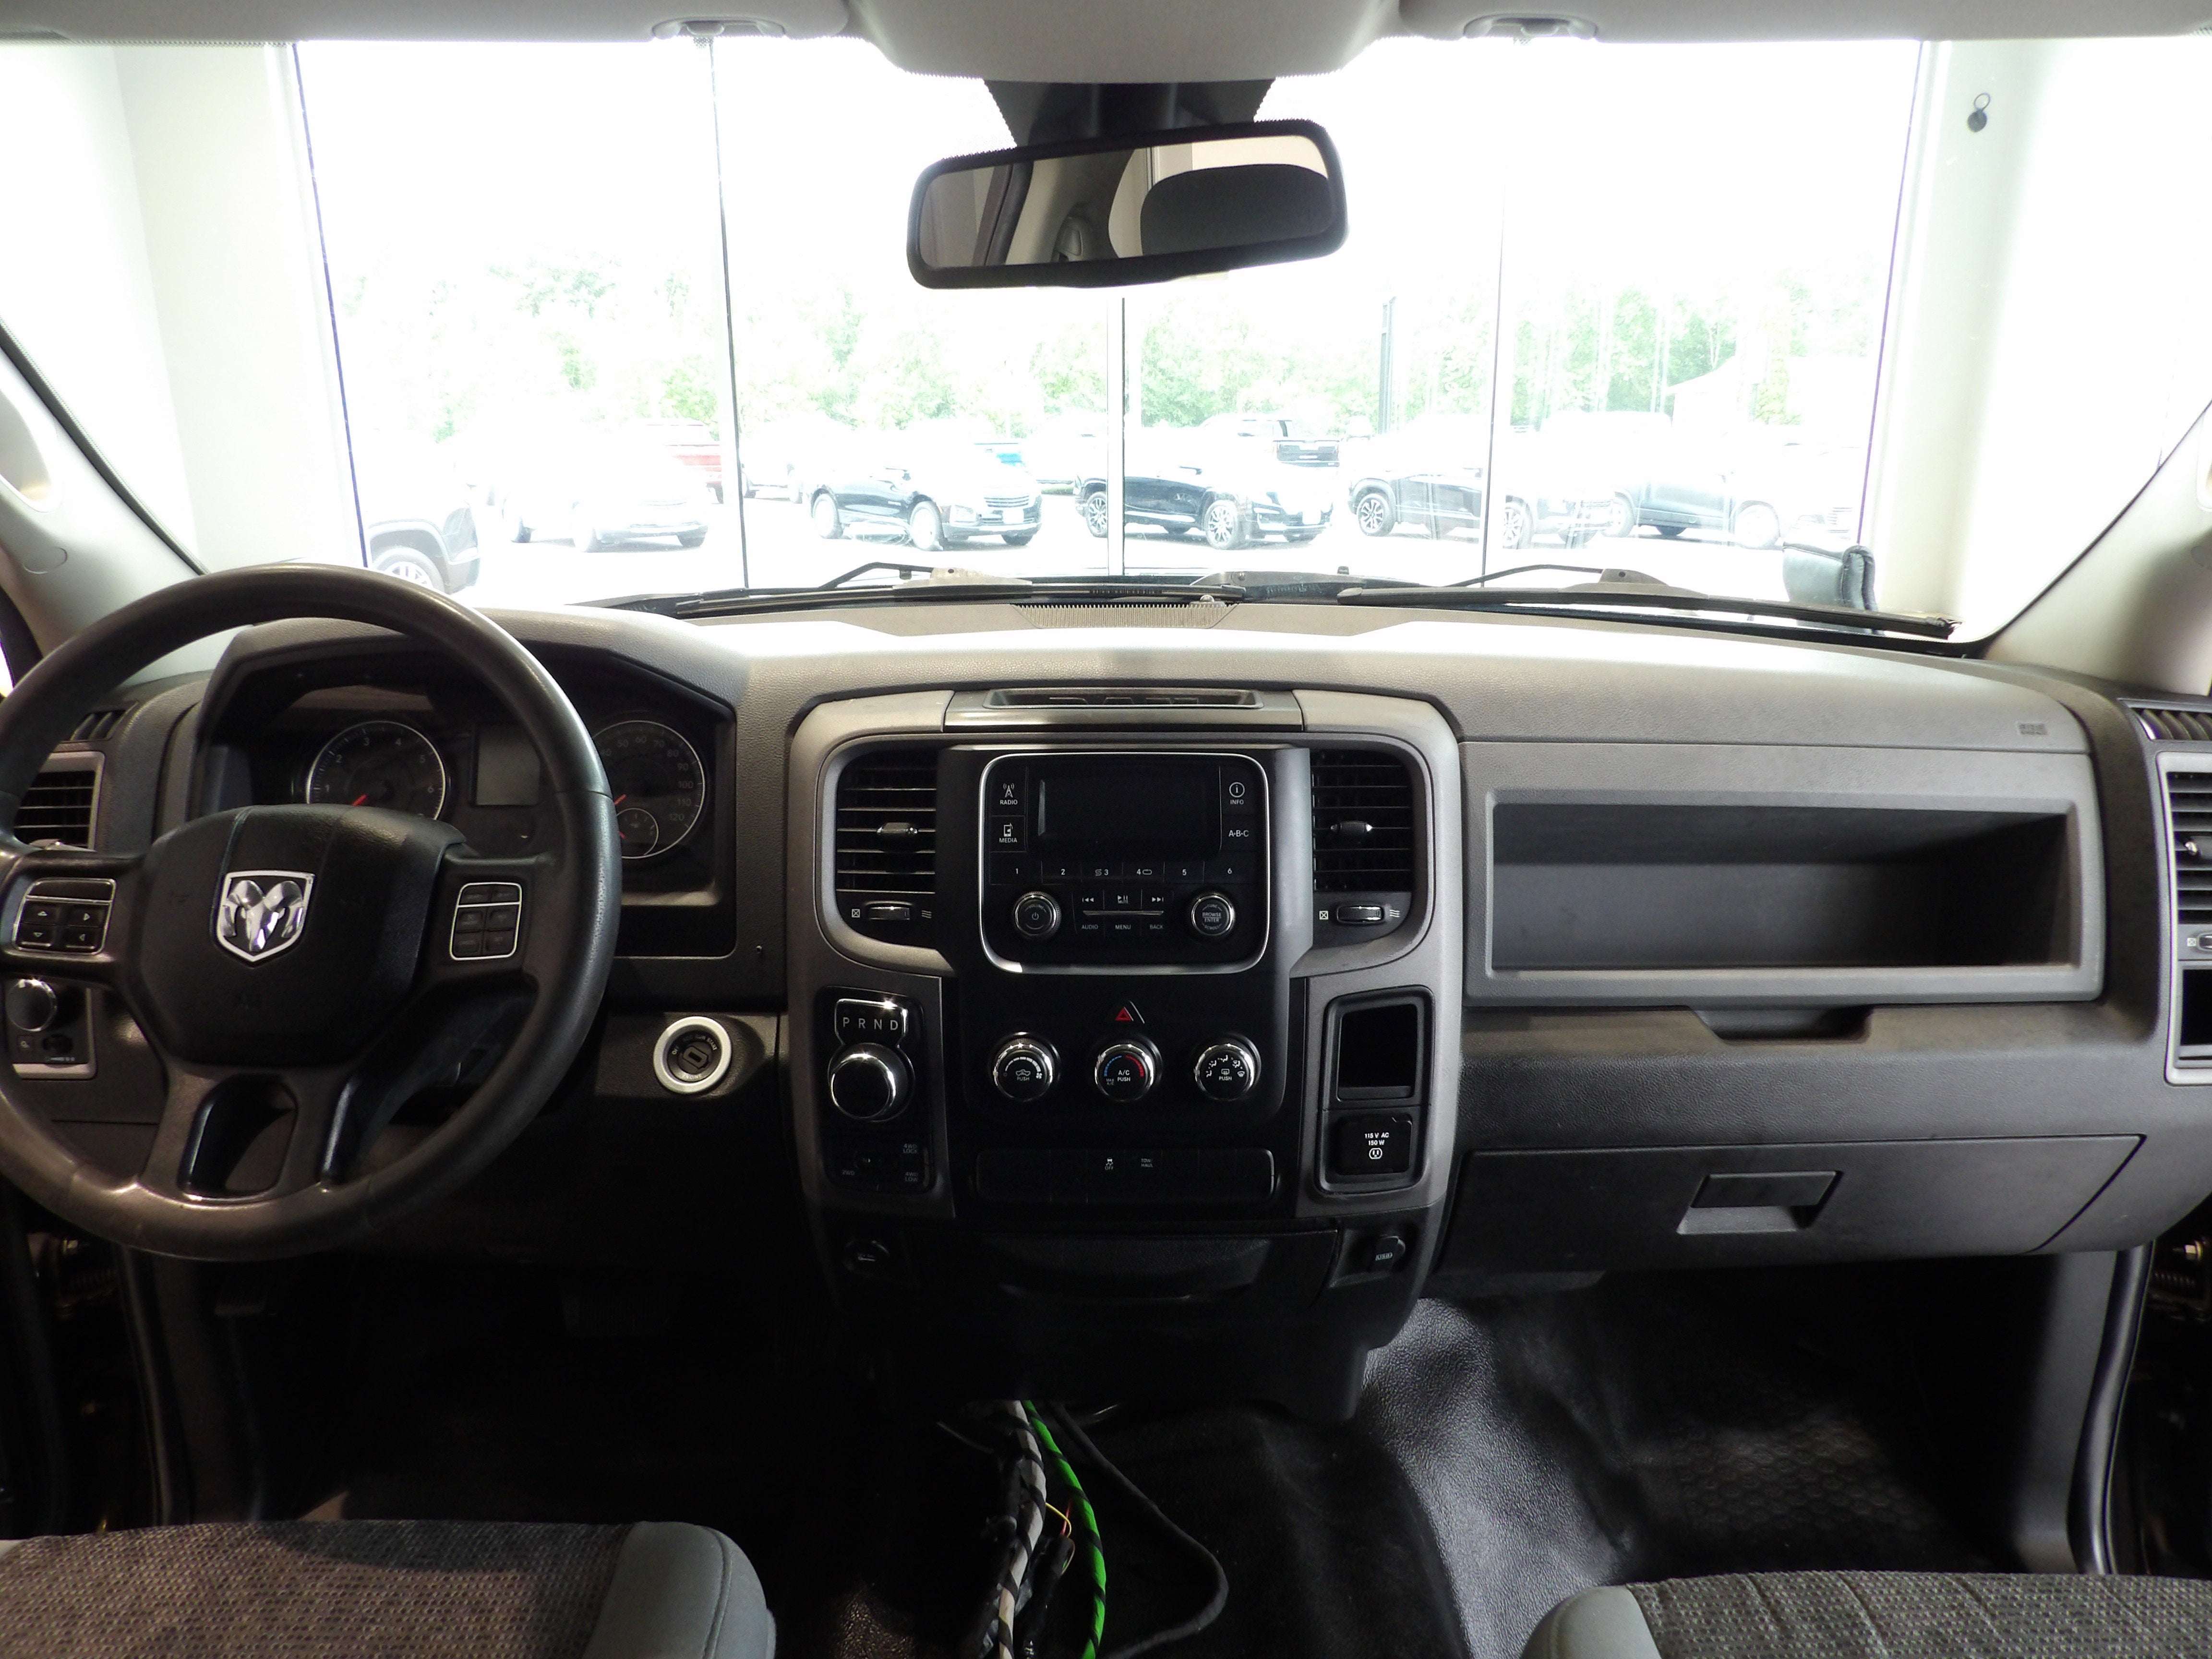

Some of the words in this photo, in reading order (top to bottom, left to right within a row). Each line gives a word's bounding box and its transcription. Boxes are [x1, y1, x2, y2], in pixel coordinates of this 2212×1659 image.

[363, 737, 370, 746] 3
[395, 737, 401, 746] 4
[667, 749, 679, 757] 80
[336, 754, 343, 763] 2
[419, 755, 426, 763] 5
[325, 784, 330, 793] 1
[427, 785, 434, 793] 6
[678, 781, 694, 789] 100
[677, 798, 692, 806] 110
[842, 1017, 850, 1028] P
[858, 1018, 866, 1029] R
[874, 1019, 882, 1030] N
[890, 1020, 899, 1031] D
[706, 1037, 718, 1051] START
